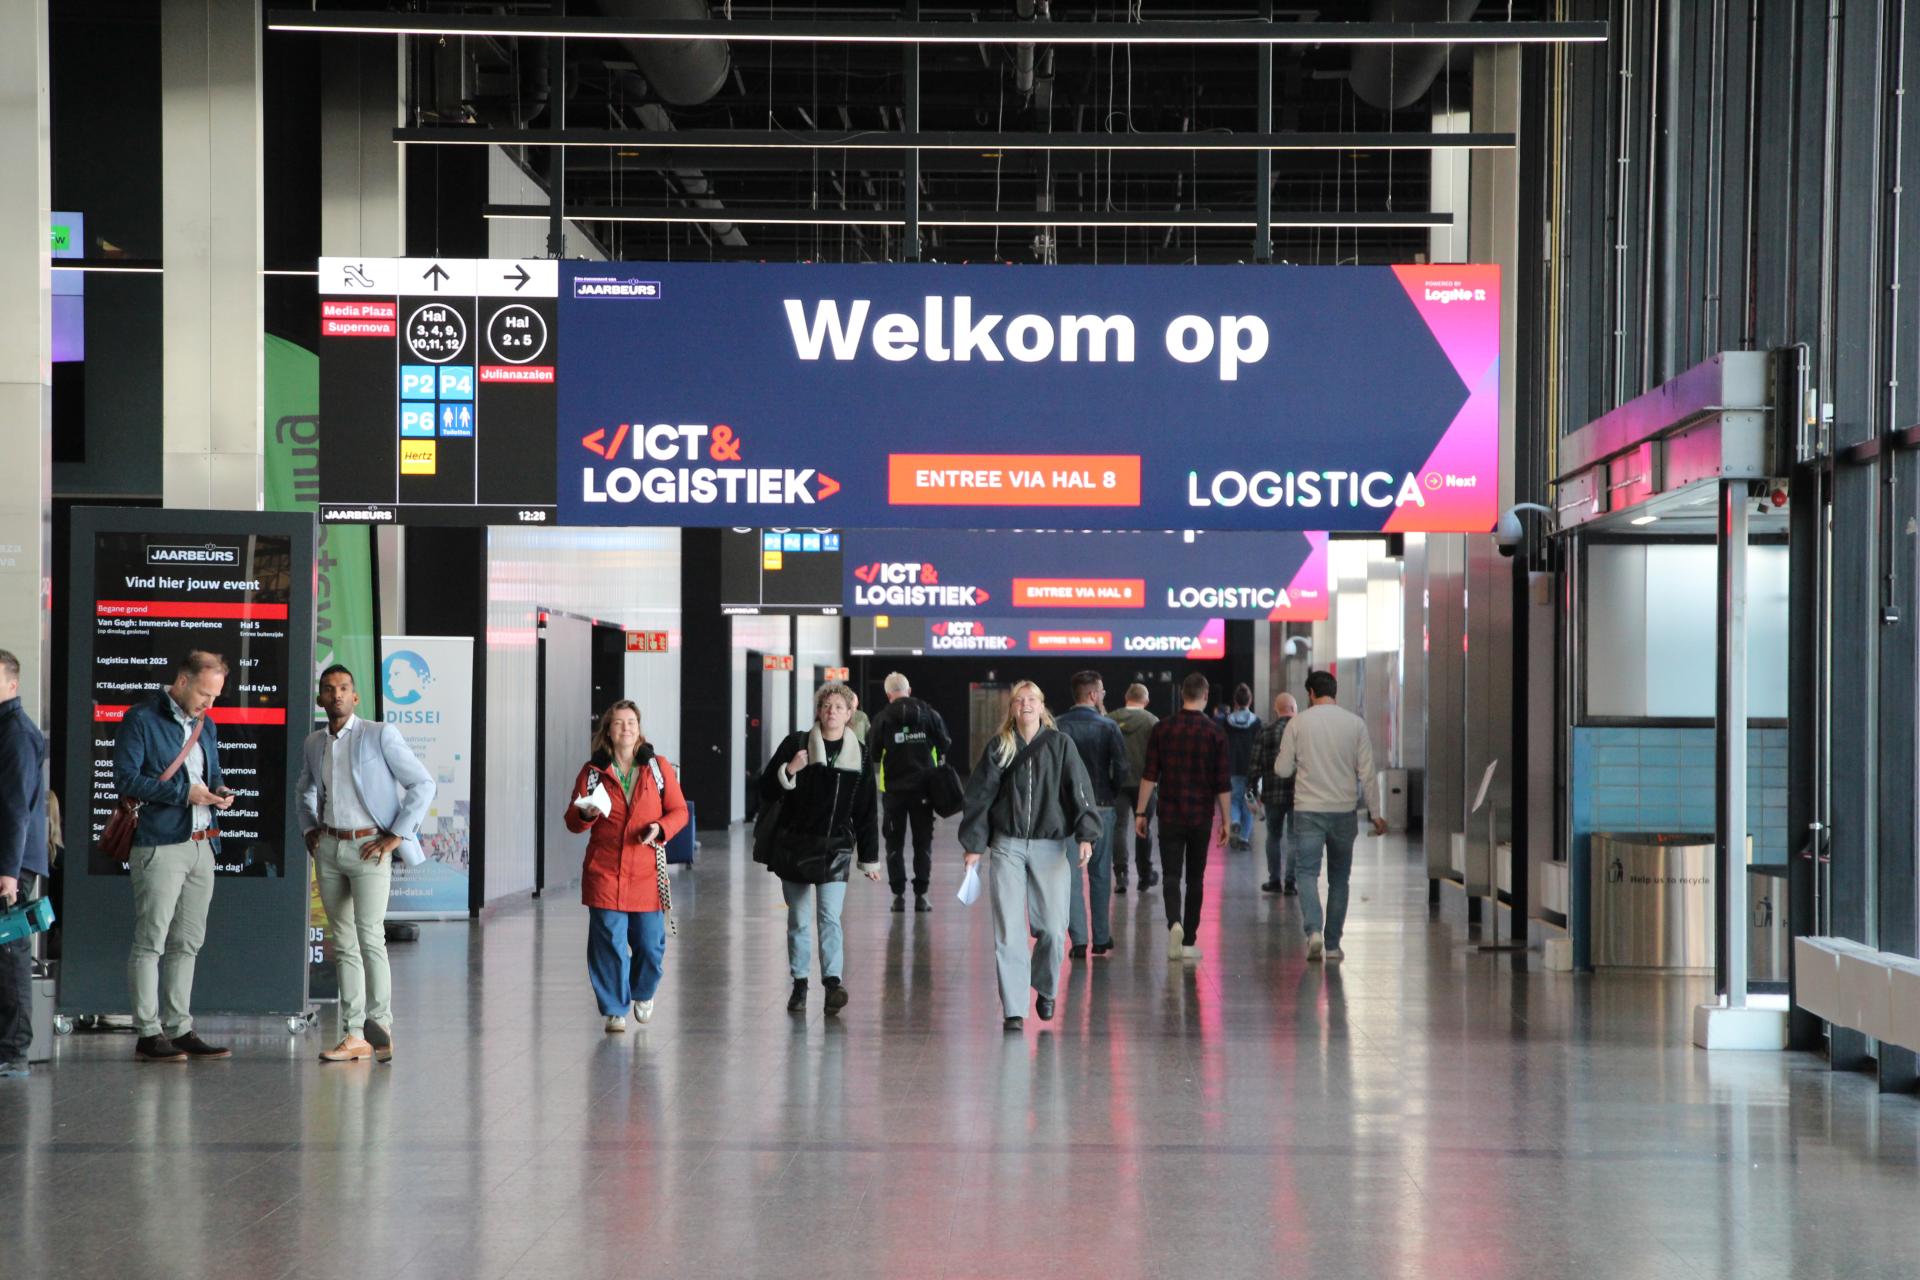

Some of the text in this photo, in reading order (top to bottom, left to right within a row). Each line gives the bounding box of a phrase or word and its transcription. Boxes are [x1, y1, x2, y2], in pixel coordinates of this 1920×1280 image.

[577, 285, 656, 295] JAARBEURS
[324, 306, 393, 316] Media Plaza
[423, 310, 446, 322] Hal
[328, 322, 390, 333] Supernova
[505, 316, 529, 328] Hal
[417, 325, 457, 337] 3, 4, 9,
[446, 339, 459, 349] 12
[503, 334, 511, 346] 2
[523, 335, 532, 345] 5
[783, 296, 1270, 381] Welkom op
[481, 369, 553, 380] Julianazalen
[403, 375, 433, 393] P2
[441, 375, 472, 393] P4
[403, 412, 433, 430] P6
[405, 452, 432, 460] Hertz
[915, 470, 1116, 488] ENTREE VIA HAL 8
[1446, 475, 1476, 487] Next
[1188, 470, 1425, 508] LOGISTICA
[324, 511, 392, 520] JAARBEURS
[518, 511, 546, 521] 12:28
[151, 551, 234, 561] JAARBEURS
[125, 576, 260, 592] Vind hier jouw event
[1027, 587, 1132, 598] ENTREE VIA HAL 8
[1168, 587, 1291, 608] LOGISTICA
[98, 605, 124, 613] Begane
[114, 619, 137, 628] Gogh:
[139, 620, 178, 628] Immersive
[181, 621, 223, 629] Experience
[1124, 636, 1202, 650] LOGISTICA
[97, 657, 128, 666] Logistica
[130, 657, 148, 665] Next
[96, 682, 142, 690] ICT&Logistiek
[383, 711, 440, 723] DISSEI
[217, 741, 257, 749] Supernova
[94, 770, 114, 778] Socia
[221, 767, 257, 775] upernova
[216, 809, 259, 817] MediaPlaza
[225, 863, 244, 872] dag!
[1630, 875, 1651, 886] Help
[1679, 876, 1710, 886] recycle
